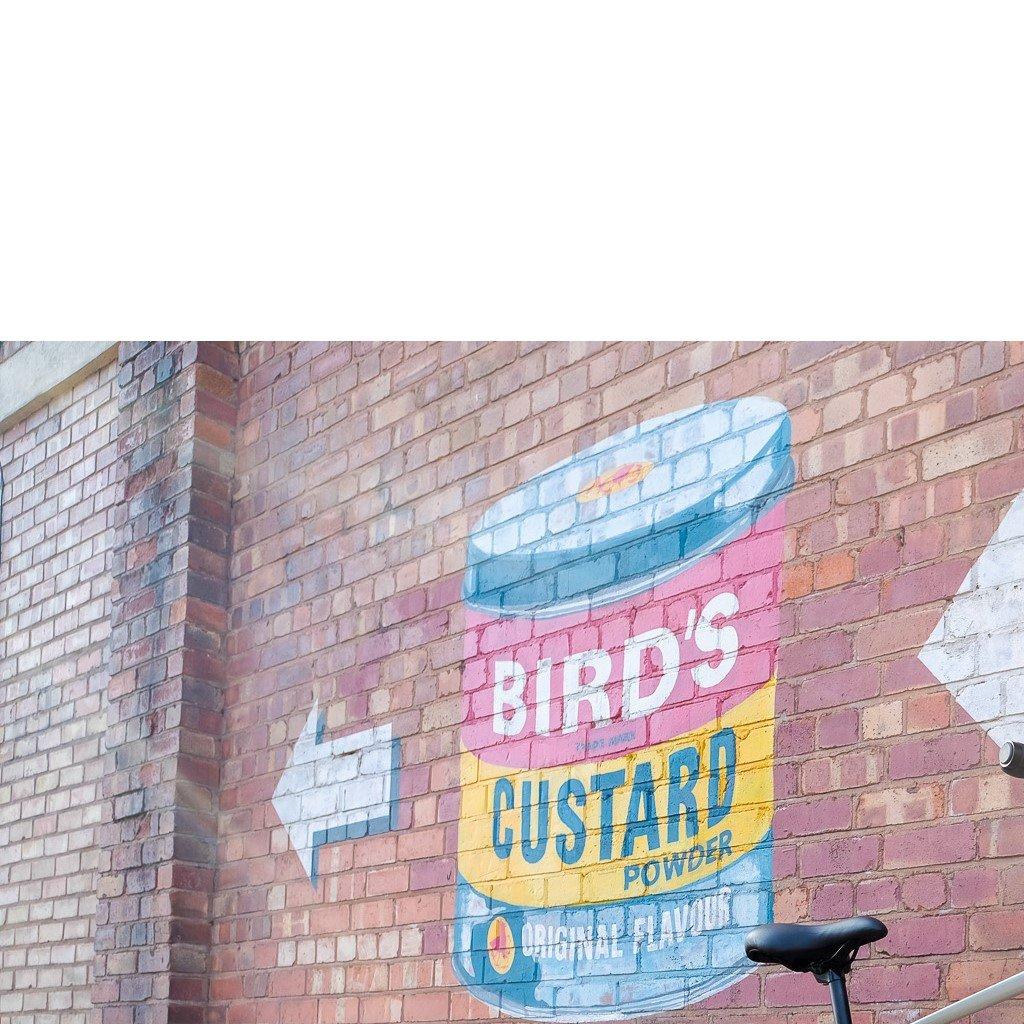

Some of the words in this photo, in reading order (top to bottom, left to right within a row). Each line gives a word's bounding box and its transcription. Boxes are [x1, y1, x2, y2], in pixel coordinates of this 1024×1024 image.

[493, 592, 738, 736] BIRD'S
[493, 728, 735, 865] CUSTARD
[624, 830, 733, 890] POWDER
[521, 921, 623, 960] ORIGINAL
[633, 886, 731, 954] FLAVOUR
